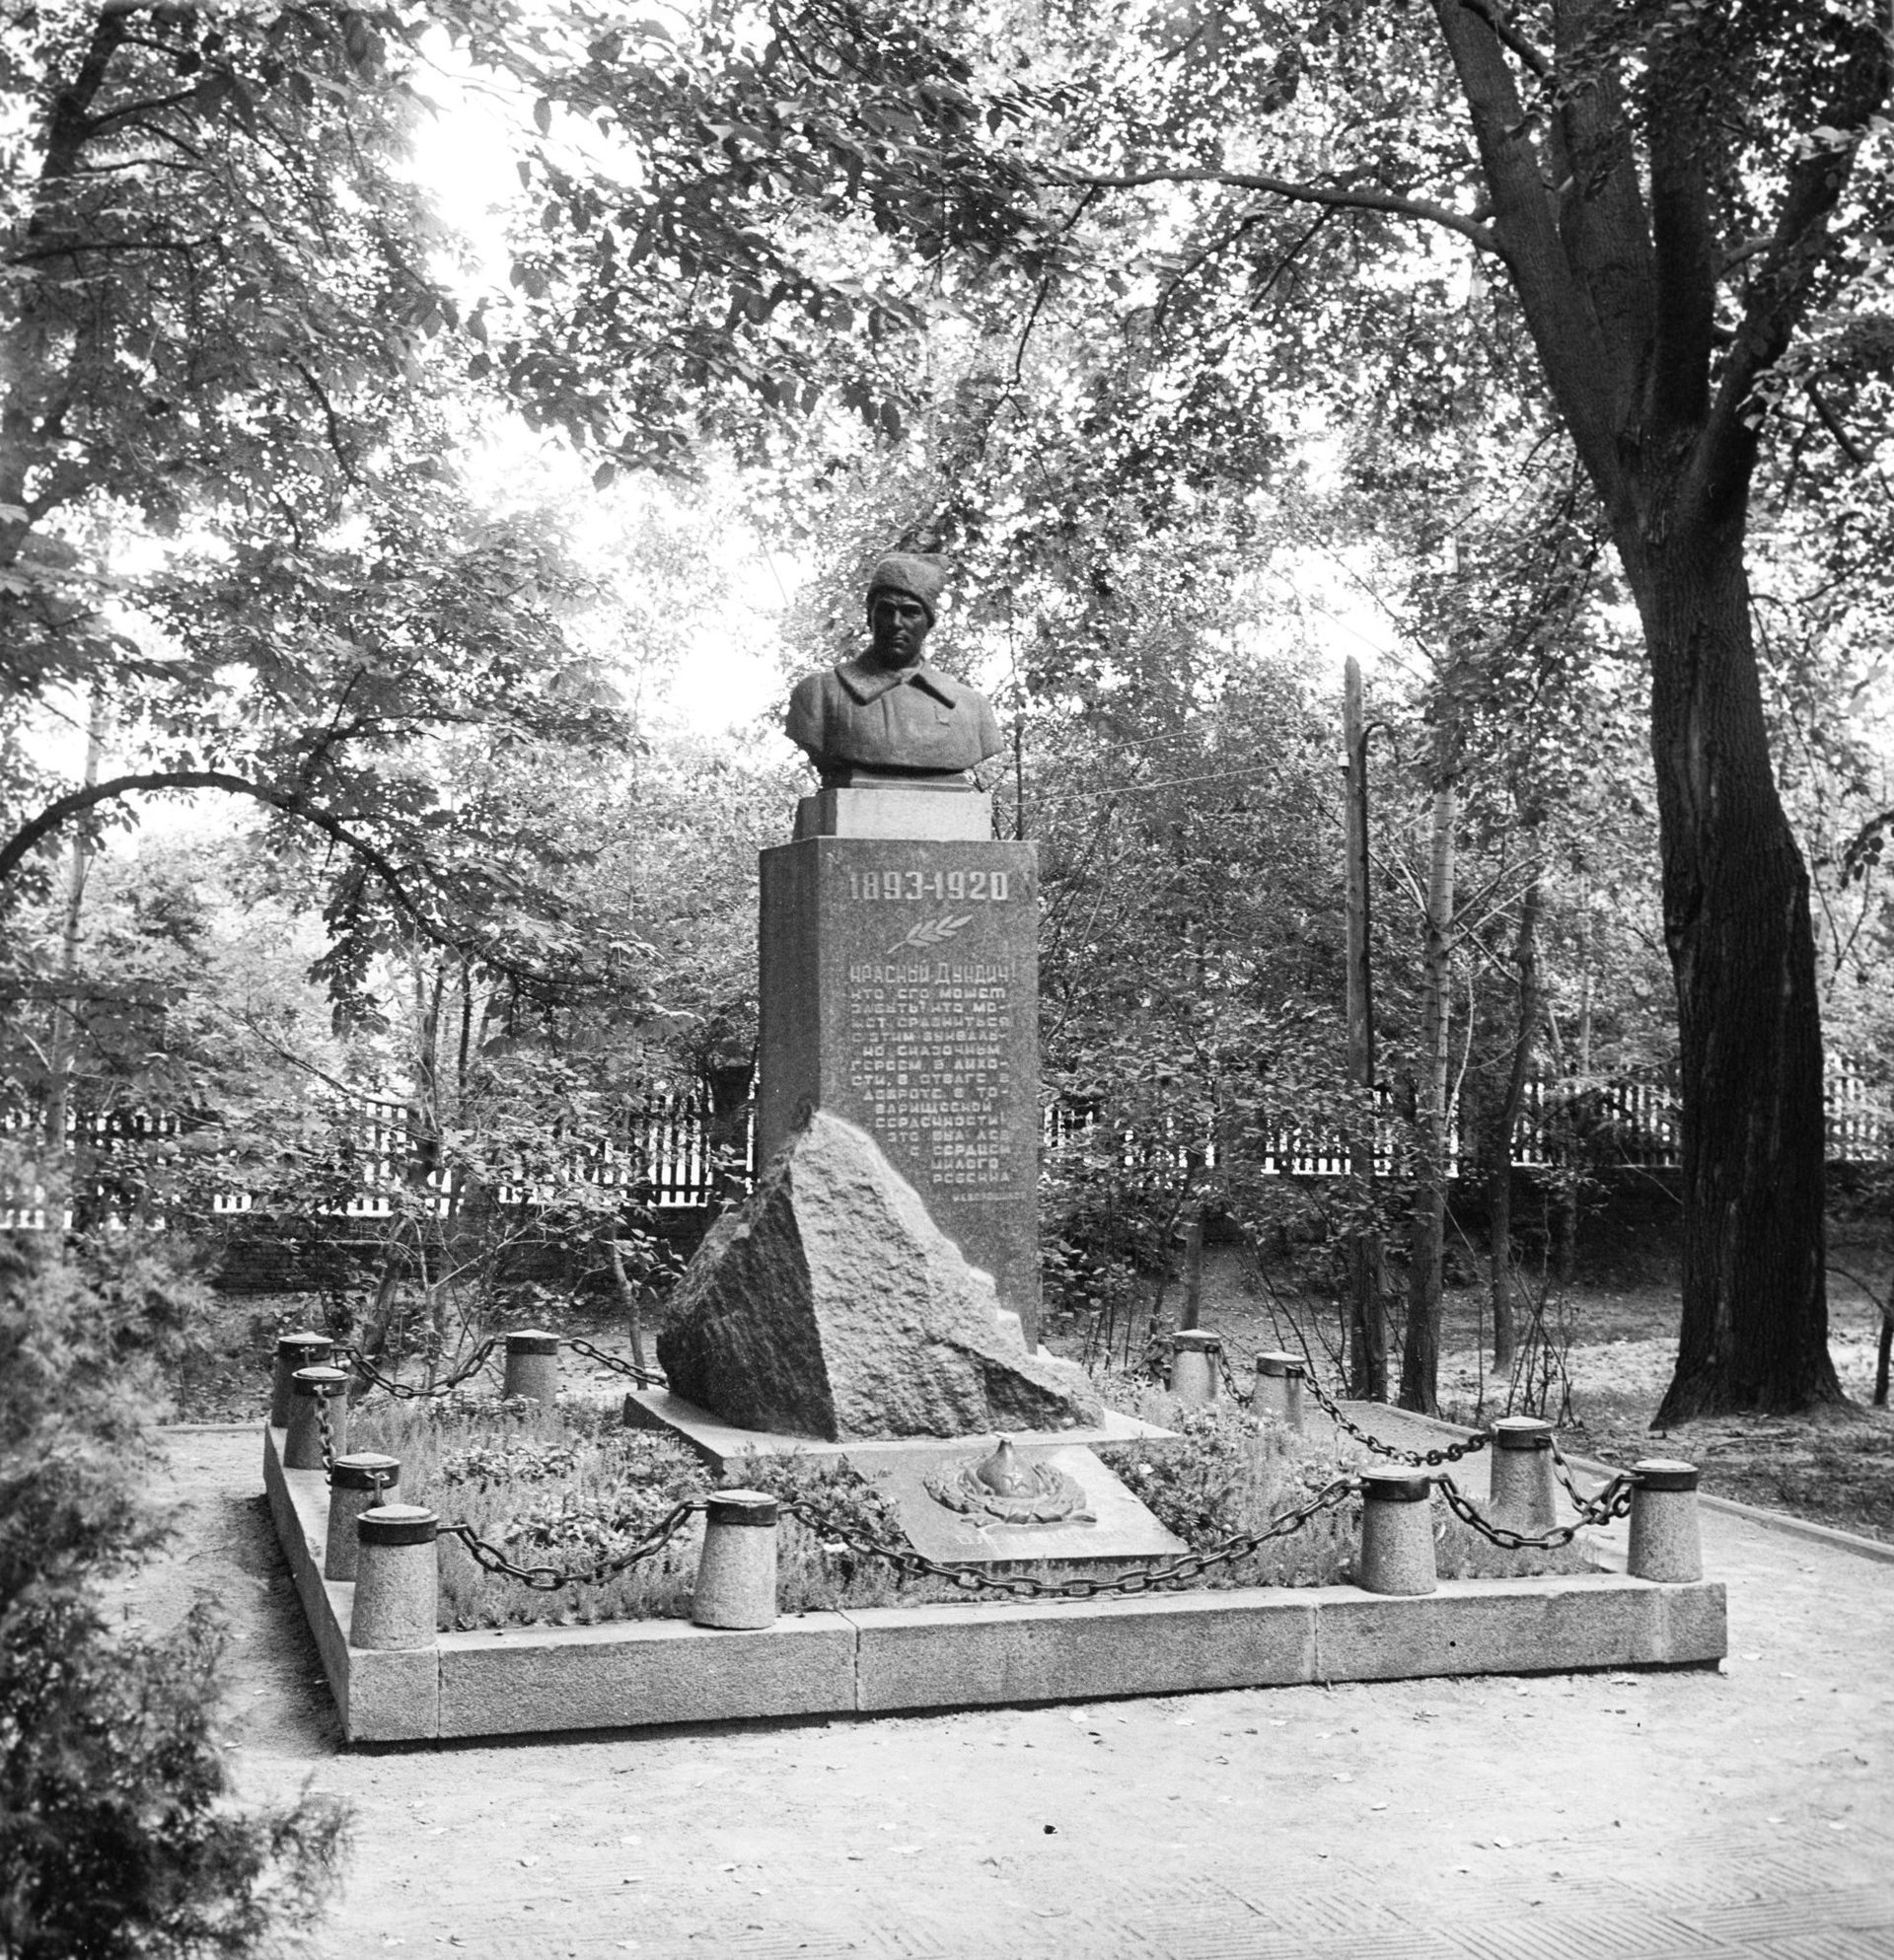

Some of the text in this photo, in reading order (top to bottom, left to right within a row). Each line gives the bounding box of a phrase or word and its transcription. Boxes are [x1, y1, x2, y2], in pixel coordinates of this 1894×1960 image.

[849, 871, 1008, 900] 1893-1920
[850, 961, 1017, 984] КРАСНЫЙ ДУНДИЧ!
[898, 987, 929, 999] ЕГО
[898, 1016, 1011, 1028] СРАВНИТЬСЯ
[851, 1032, 863, 1043] С
[869, 1032, 914, 1043] ЭТИМ
[862, 1045, 1000, 1056] НО СКАЗОЧНЫМ
[850, 1059, 922, 1071] ГЕРОЕМ
[933, 1058, 945, 1070] В
[897, 1073, 909, 1085] В
[998, 1072, 1010, 1084] В
[953, 1087, 965, 1098] В
[875, 1098, 992, 1115] ВАРИЩЕСКОЙ
[888, 1129, 1010, 1142] ЭТО БЫЛ ЛЕВ
[910, 1144, 1011, 1156] С СЕРДЦЕМ
[931, 1158, 999, 1170] МИЛОГО
